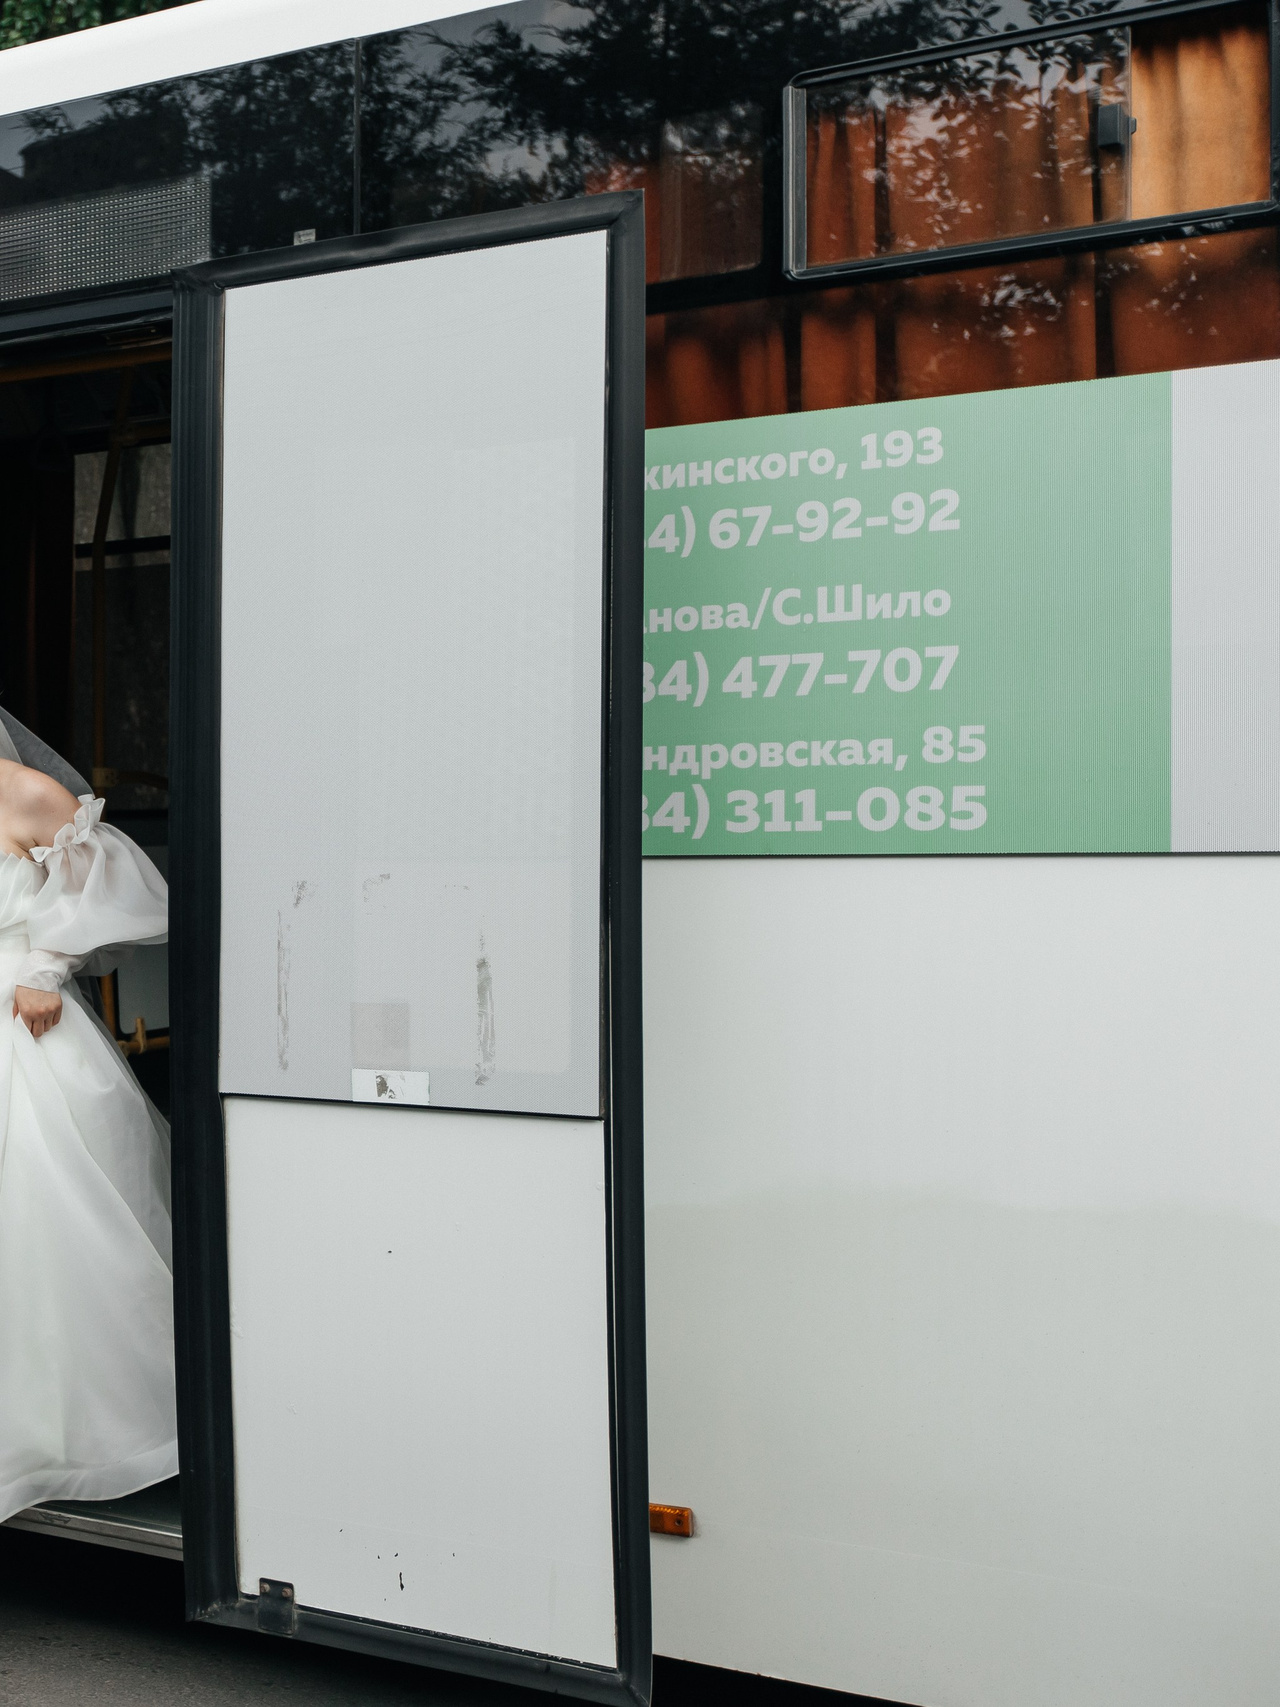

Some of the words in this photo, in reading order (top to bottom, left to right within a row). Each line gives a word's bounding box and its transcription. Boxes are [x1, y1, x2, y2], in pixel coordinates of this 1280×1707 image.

[860, 426, 945, 470] 193
[644, 505, 697, 558] 4)
[708, 488, 961, 550] 67-92-92
[643, 583, 952, 635] нова/С.Шило
[722, 645, 960, 699] 477-707
[921, 724, 987, 764] 85
[642, 783, 710, 840] 4)
[726, 785, 988, 834] 311-085
